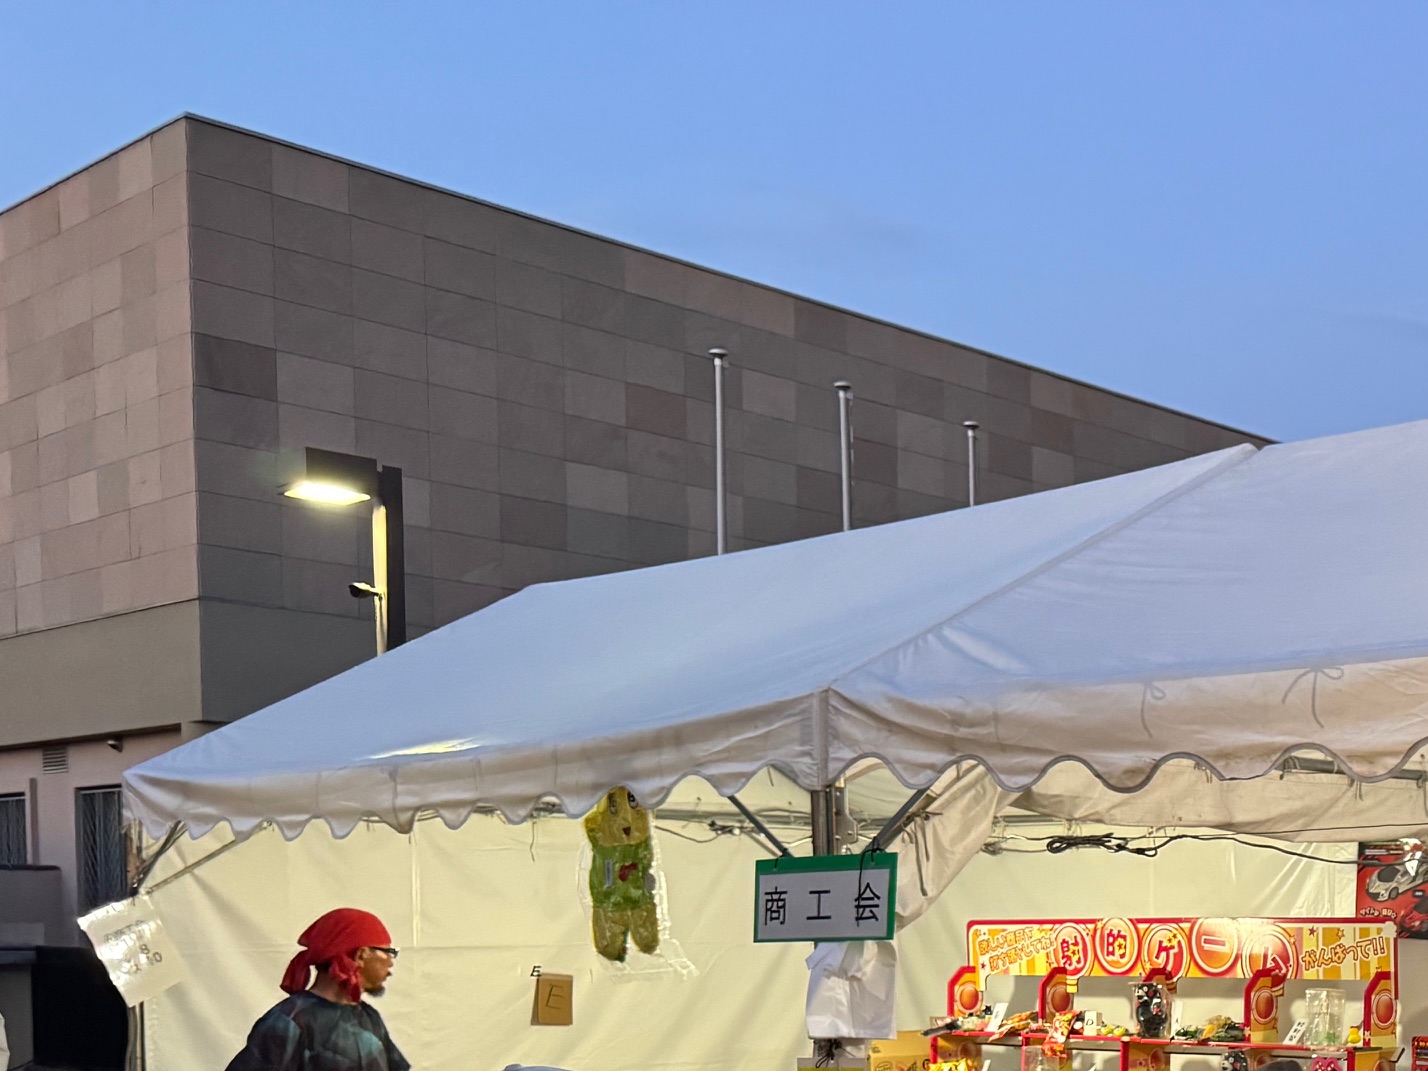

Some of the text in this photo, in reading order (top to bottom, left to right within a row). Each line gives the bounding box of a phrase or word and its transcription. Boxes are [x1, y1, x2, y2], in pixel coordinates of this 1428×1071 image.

[764, 882, 881, 925] 商工会
[1059, 927, 1288, 976] 射的ゲーム
[1301, 936, 1386, 972] がんばって!!
[545, 983, 565, 1010] E
